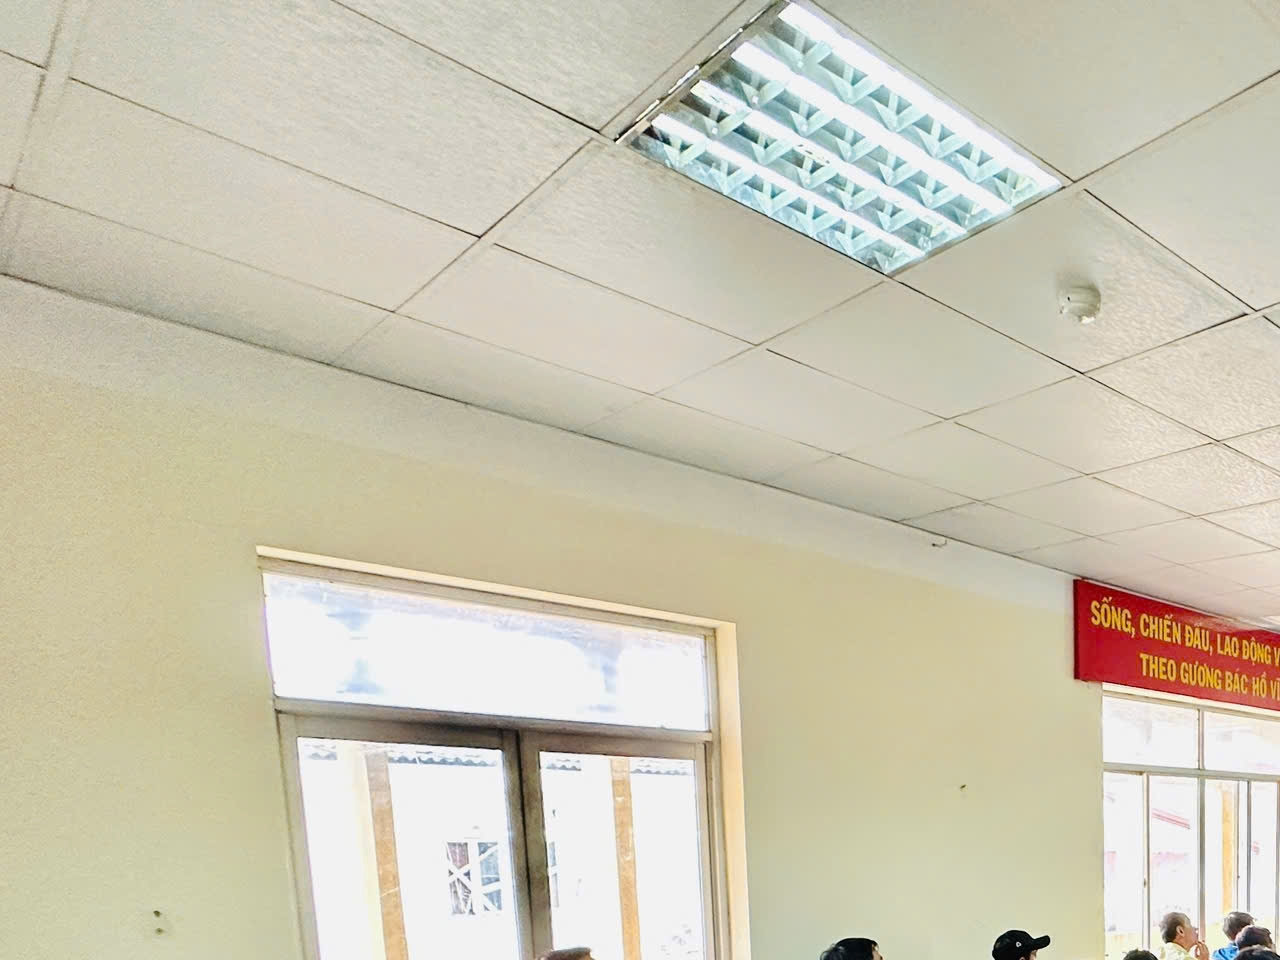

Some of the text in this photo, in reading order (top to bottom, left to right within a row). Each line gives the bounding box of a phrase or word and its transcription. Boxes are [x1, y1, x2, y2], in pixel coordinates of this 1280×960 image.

[1091, 596, 1135, 638] SỐNG,
[1139, 614, 1181, 645] CHIẾN
[1184, 621, 1213, 656] ĐẤU,
[1217, 633, 1239, 657] LAO
[1242, 637, 1271, 666] ĐỘNG
[1140, 653, 1177, 682] THEO
[1180, 660, 1222, 690] GƯƠNG
[1225, 668, 1248, 694] BÁC
[1252, 672, 1267, 698] HỒ
[1270, 678, 1280, 701] VĨ
